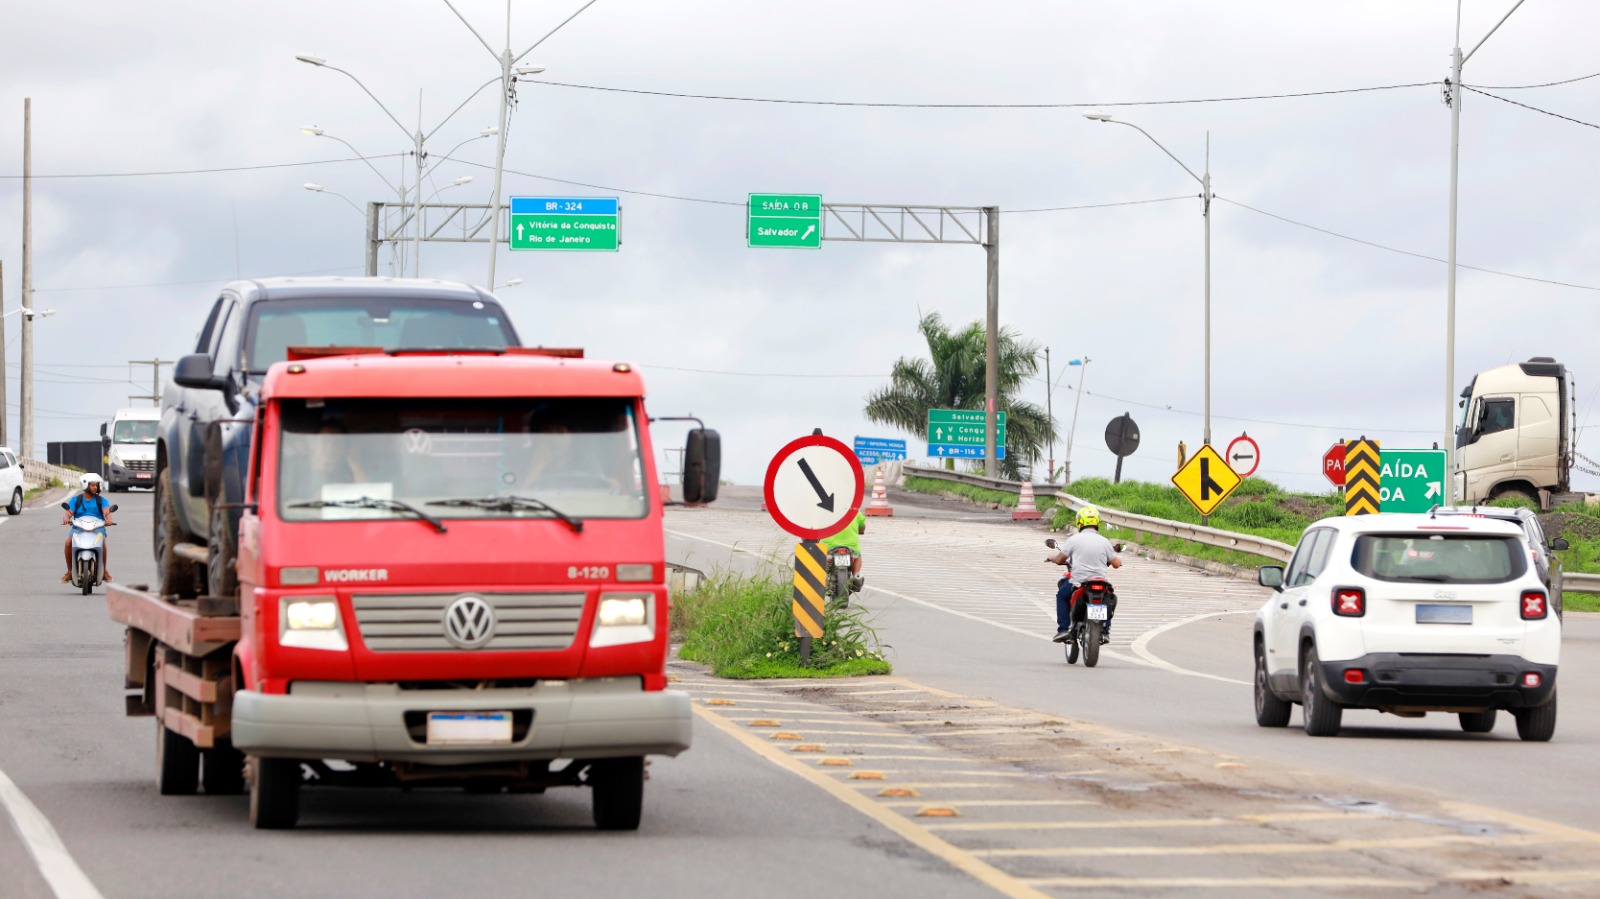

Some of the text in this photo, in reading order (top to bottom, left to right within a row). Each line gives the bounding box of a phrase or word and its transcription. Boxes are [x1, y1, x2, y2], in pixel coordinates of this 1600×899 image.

[762, 199, 789, 210] SAÍDA
[529, 220, 615, 231] Vitória da Conquista
[757, 227, 799, 237] Salvador
[529, 234, 591, 244] Rio de Janeiro
[952, 413, 986, 421] Salvado
[948, 447, 976, 456] BR-116
[1326, 458, 1346, 471] PA
[1380, 458, 1428, 479] AÍDA
[324, 568, 388, 582] WORKER
[567, 566, 609, 579] 8-120
